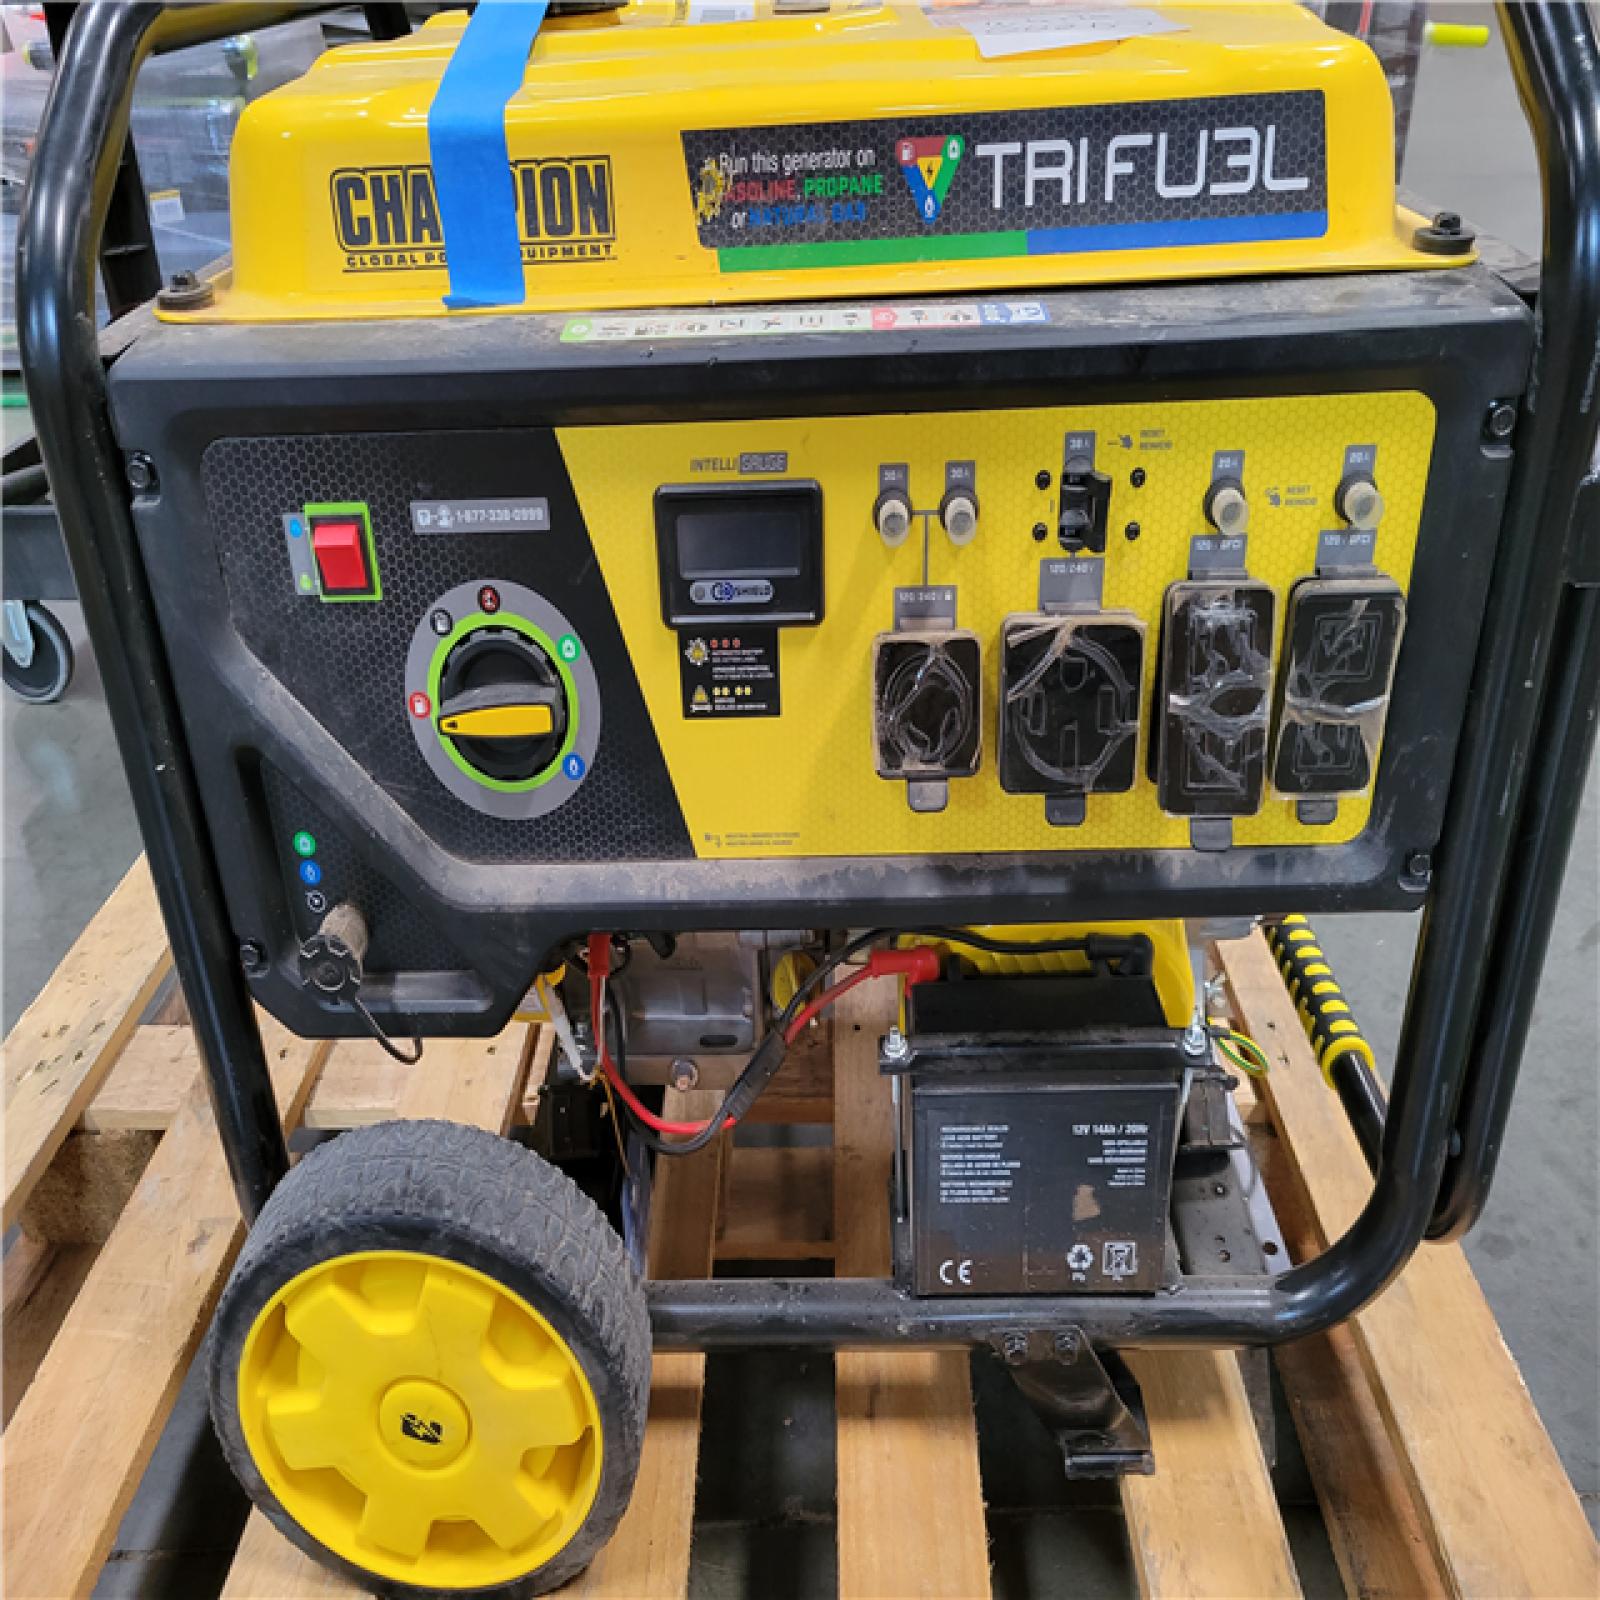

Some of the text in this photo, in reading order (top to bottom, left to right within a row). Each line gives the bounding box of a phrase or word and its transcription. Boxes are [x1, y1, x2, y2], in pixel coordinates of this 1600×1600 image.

[719, 147, 876, 175] Run this generator on
[803, 174, 884, 198] PROPANE
[335, 163, 613, 246] CHAION
[731, 212, 747, 229] or
[346, 254, 418, 266] GLOBAL
[520, 244, 612, 259] UIPMENT
[939, 1259, 974, 1286] CE
